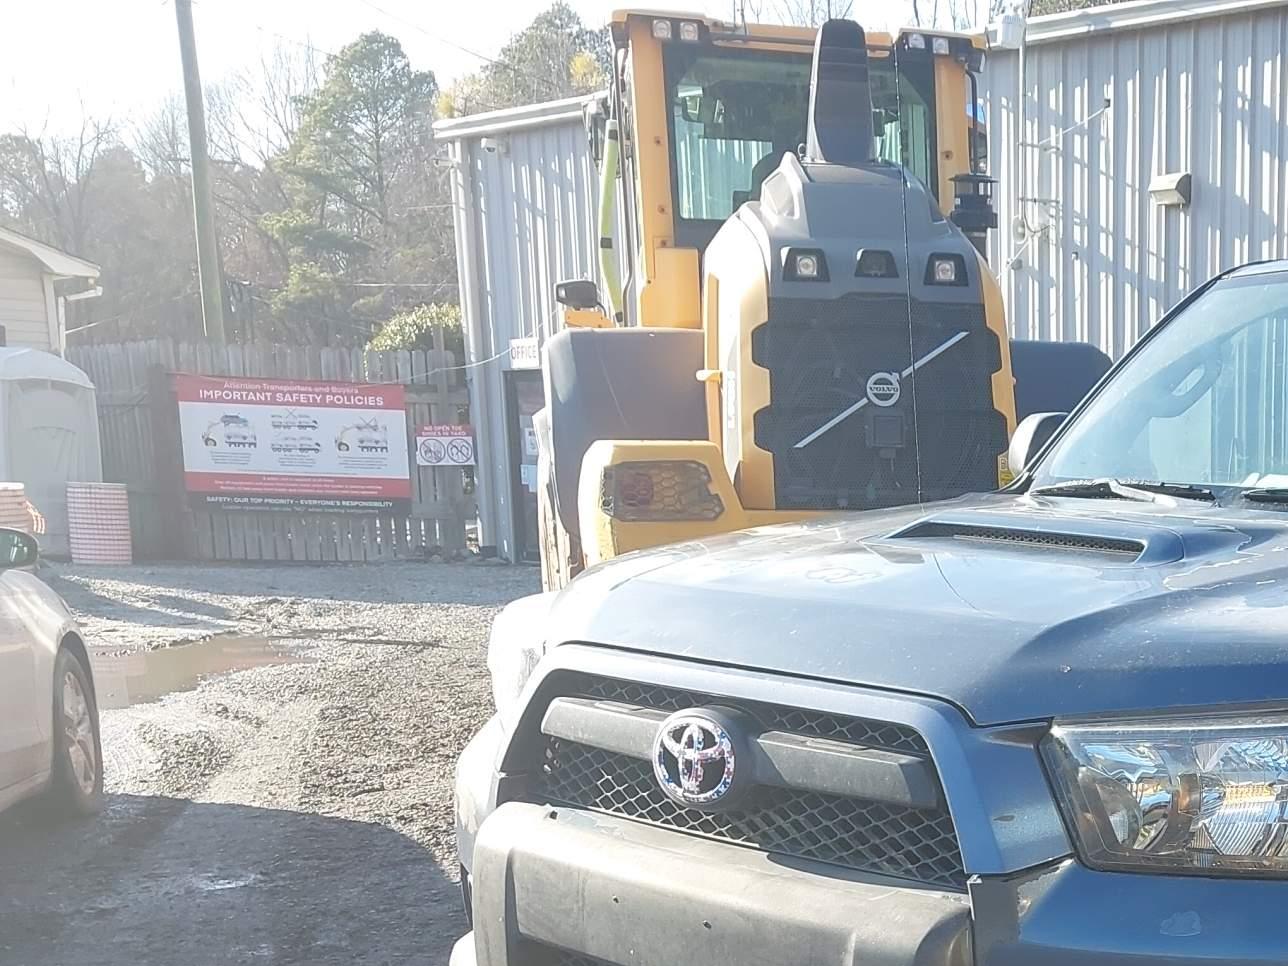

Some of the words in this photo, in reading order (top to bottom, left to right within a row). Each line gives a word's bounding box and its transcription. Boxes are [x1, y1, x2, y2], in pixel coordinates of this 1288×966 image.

[510, 344, 537, 360] OFFICE
[199, 389, 272, 401] IMPORTANT
[276, 392, 322, 403] SAFETY
[326, 394, 384, 406] POLICIES
